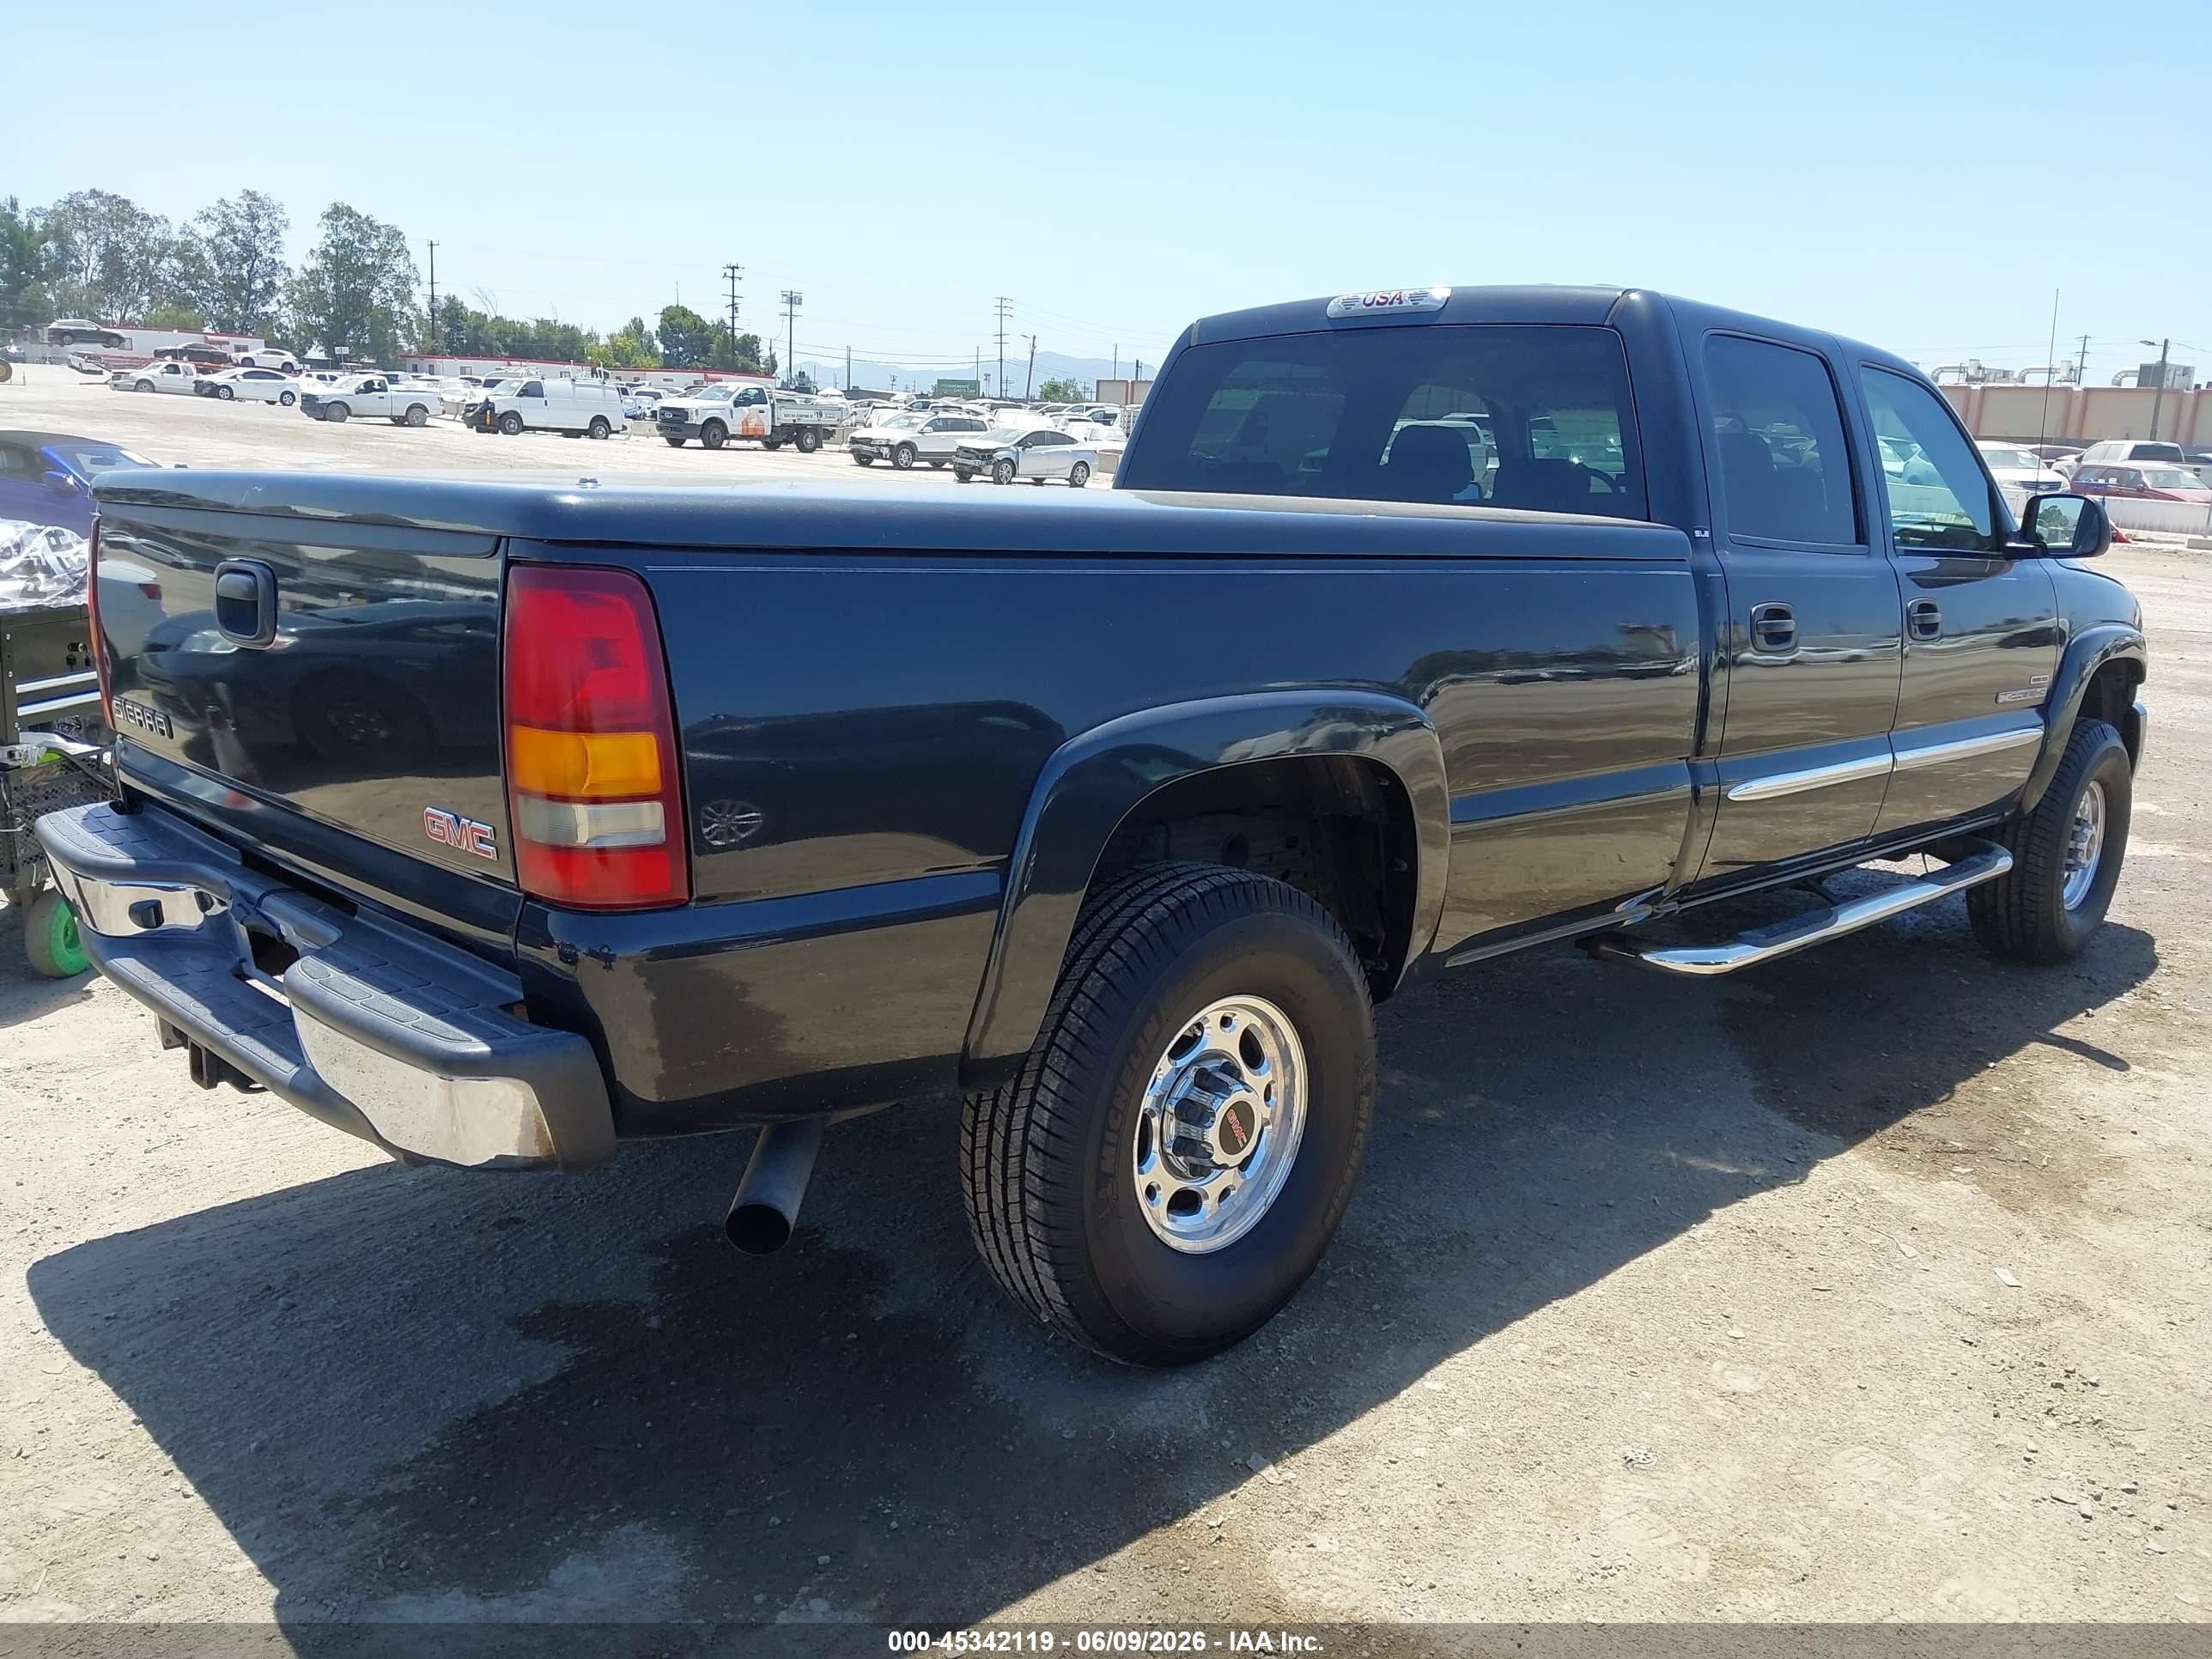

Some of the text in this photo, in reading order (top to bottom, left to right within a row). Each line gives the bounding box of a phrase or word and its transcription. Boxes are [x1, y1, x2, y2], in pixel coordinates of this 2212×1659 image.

[1362, 290, 1404, 307] USA
[112, 696, 173, 739] SIERRA
[423, 806, 499, 861] GMC
[1226, 1108, 1248, 1149] GMC
